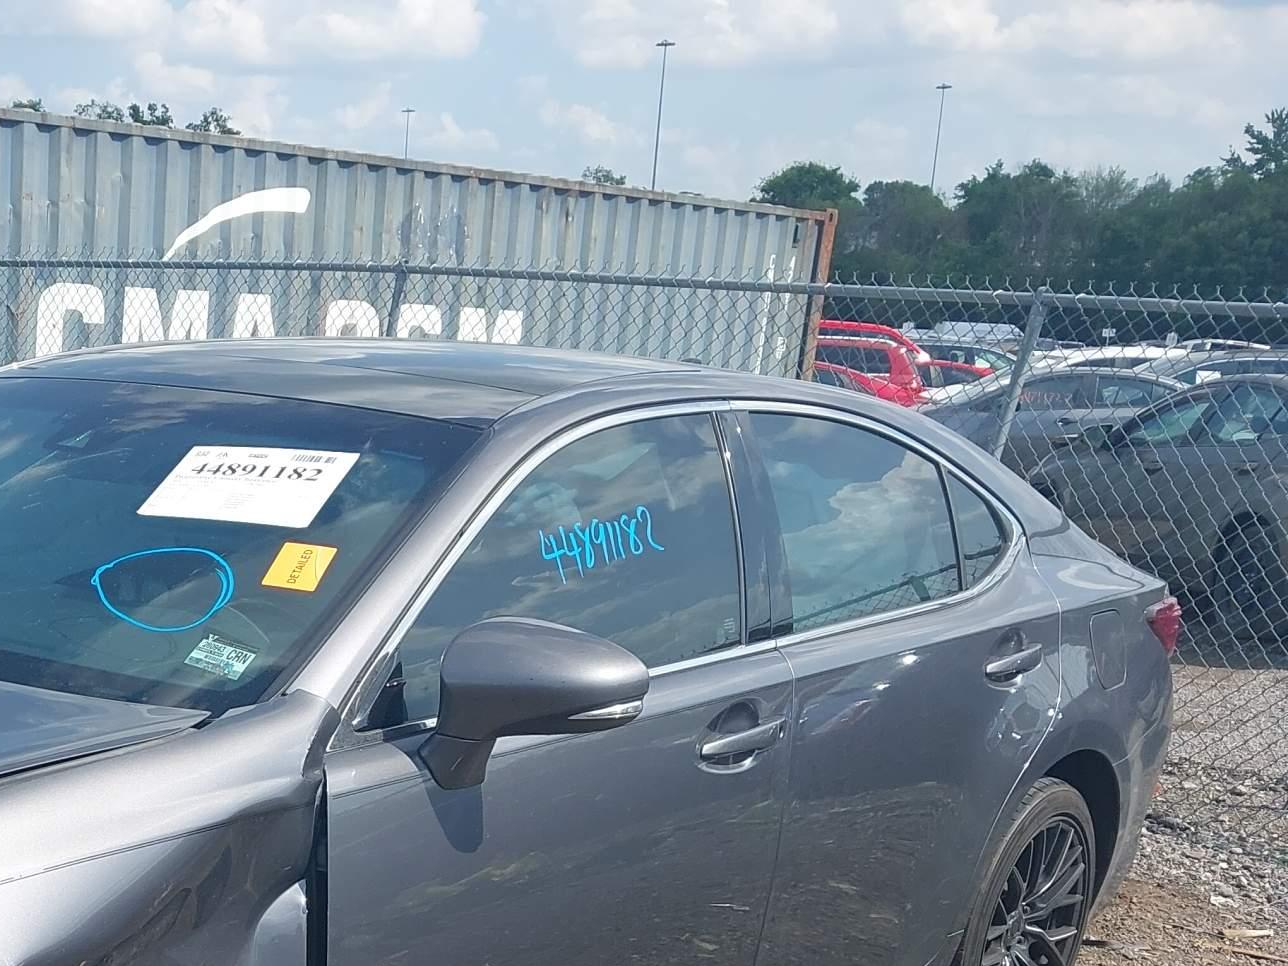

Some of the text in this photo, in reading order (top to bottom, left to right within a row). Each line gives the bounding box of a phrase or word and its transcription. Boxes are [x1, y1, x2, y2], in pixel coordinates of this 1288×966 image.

[191, 462, 323, 482] 44891182
[539, 505, 664, 585] 44891182
[286, 549, 313, 584] DETAILED
[226, 649, 252, 665] CRN
